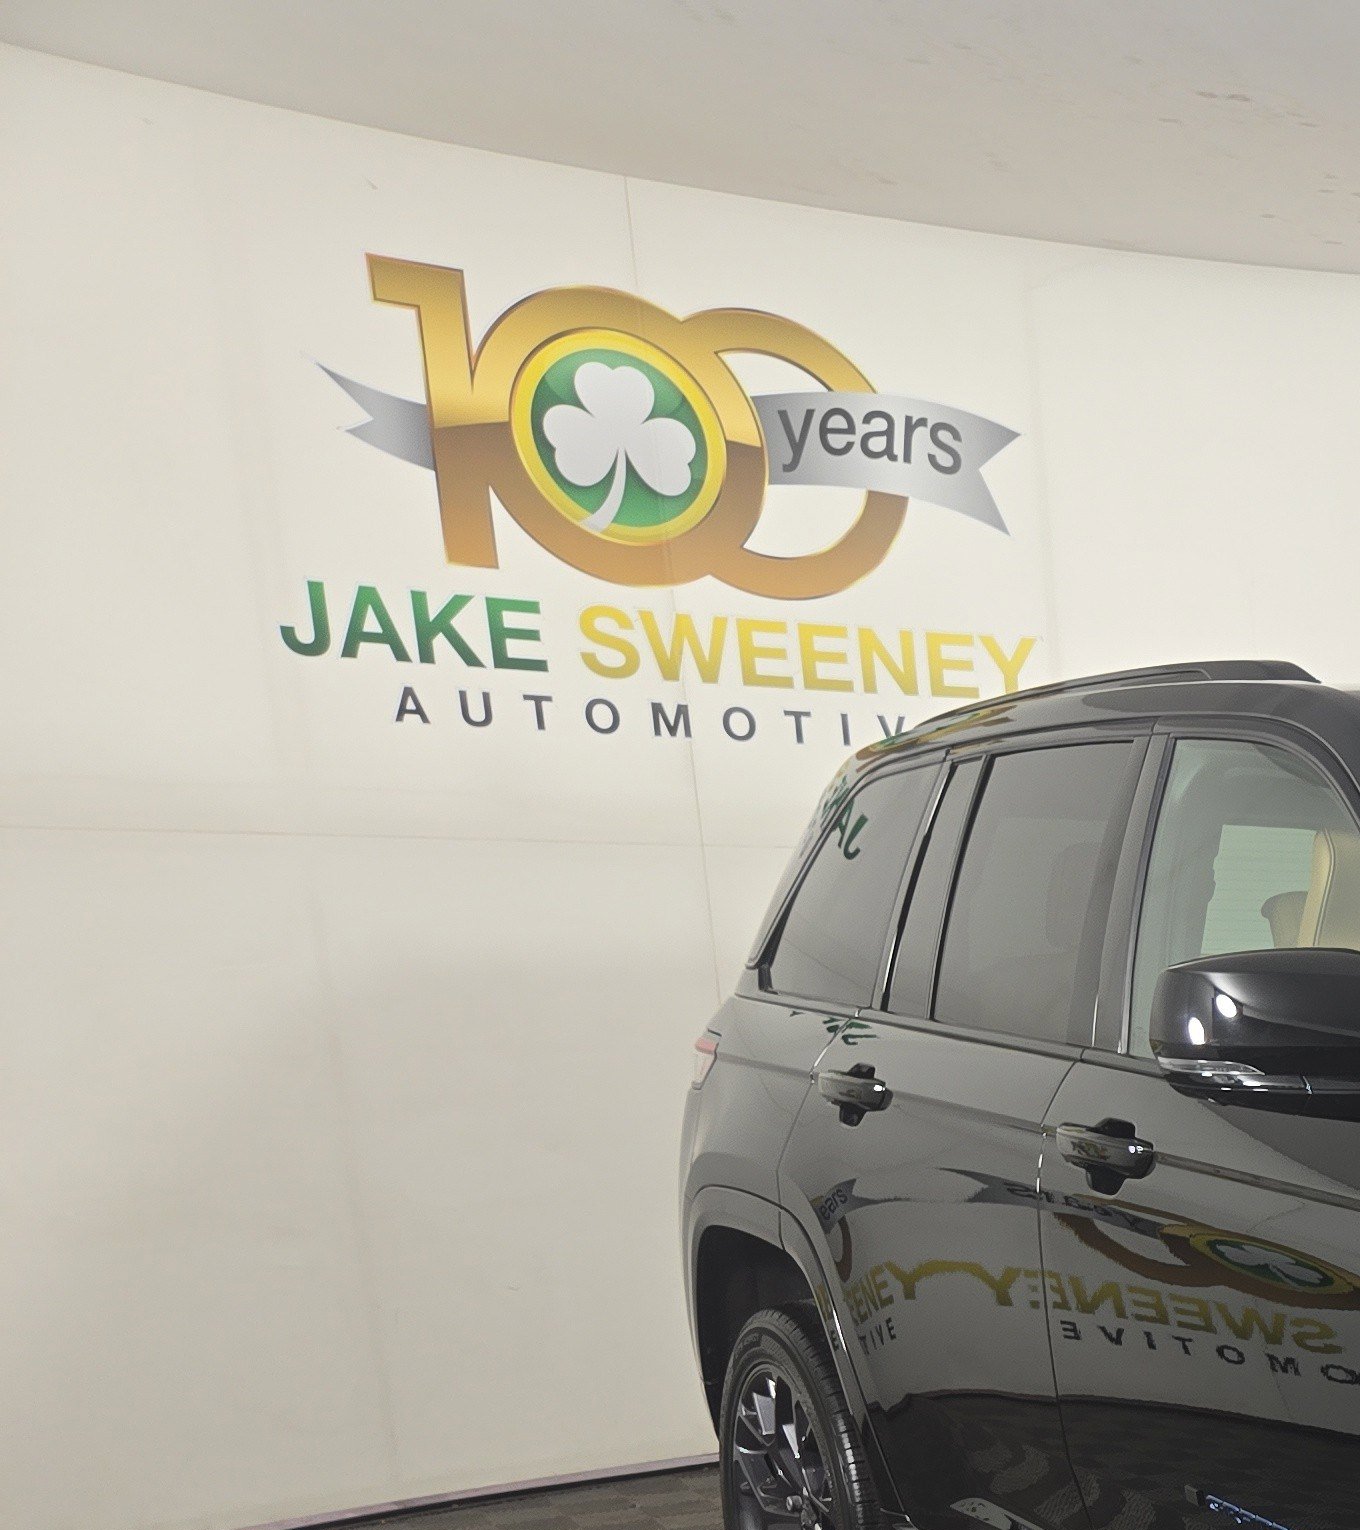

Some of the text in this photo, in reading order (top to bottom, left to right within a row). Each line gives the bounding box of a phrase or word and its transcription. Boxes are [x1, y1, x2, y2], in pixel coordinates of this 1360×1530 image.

[776, 403, 963, 476] years
[279, 579, 1038, 699] JAKE SWEENEY
[395, 684, 906, 746] AUTOMOTIV
